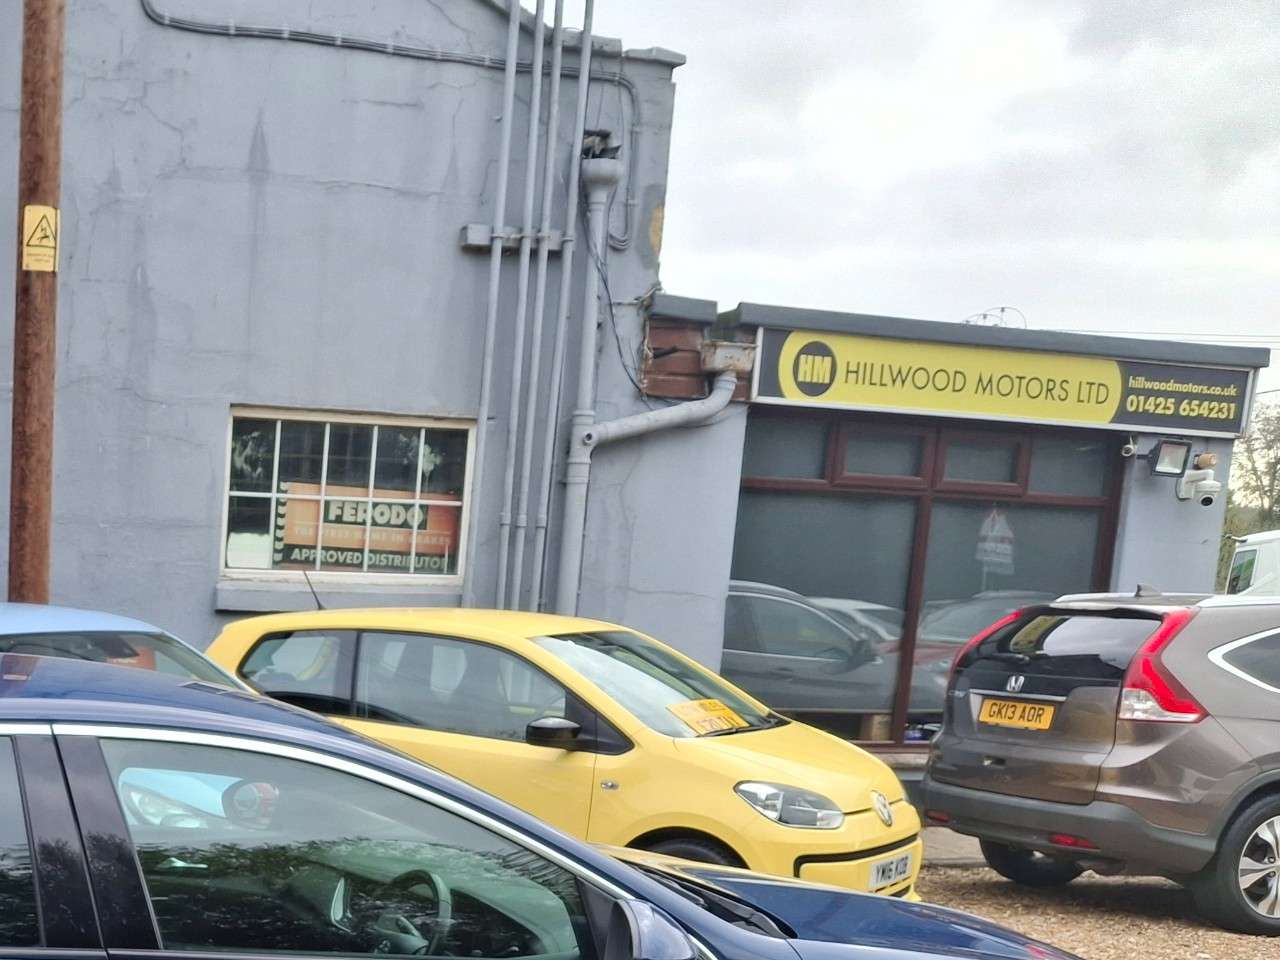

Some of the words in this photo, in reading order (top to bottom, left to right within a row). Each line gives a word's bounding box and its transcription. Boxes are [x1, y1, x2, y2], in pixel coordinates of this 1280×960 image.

[798, 354, 833, 385] HM
[845, 361, 967, 393] HILLWOOD
[974, 372, 1070, 402] MOTORS
[1077, 381, 1110, 405] LTD
[1128, 375, 1238, 397] hillwoodmotors.co.uk
[1125, 394, 1176, 416] 01425
[1178, 399, 1237, 420] 654231
[328, 499, 424, 528] FERODO
[290, 547, 363, 565] APPROVED
[988, 702, 1017, 720] GK13
[1018, 706, 1045, 724] AOR
